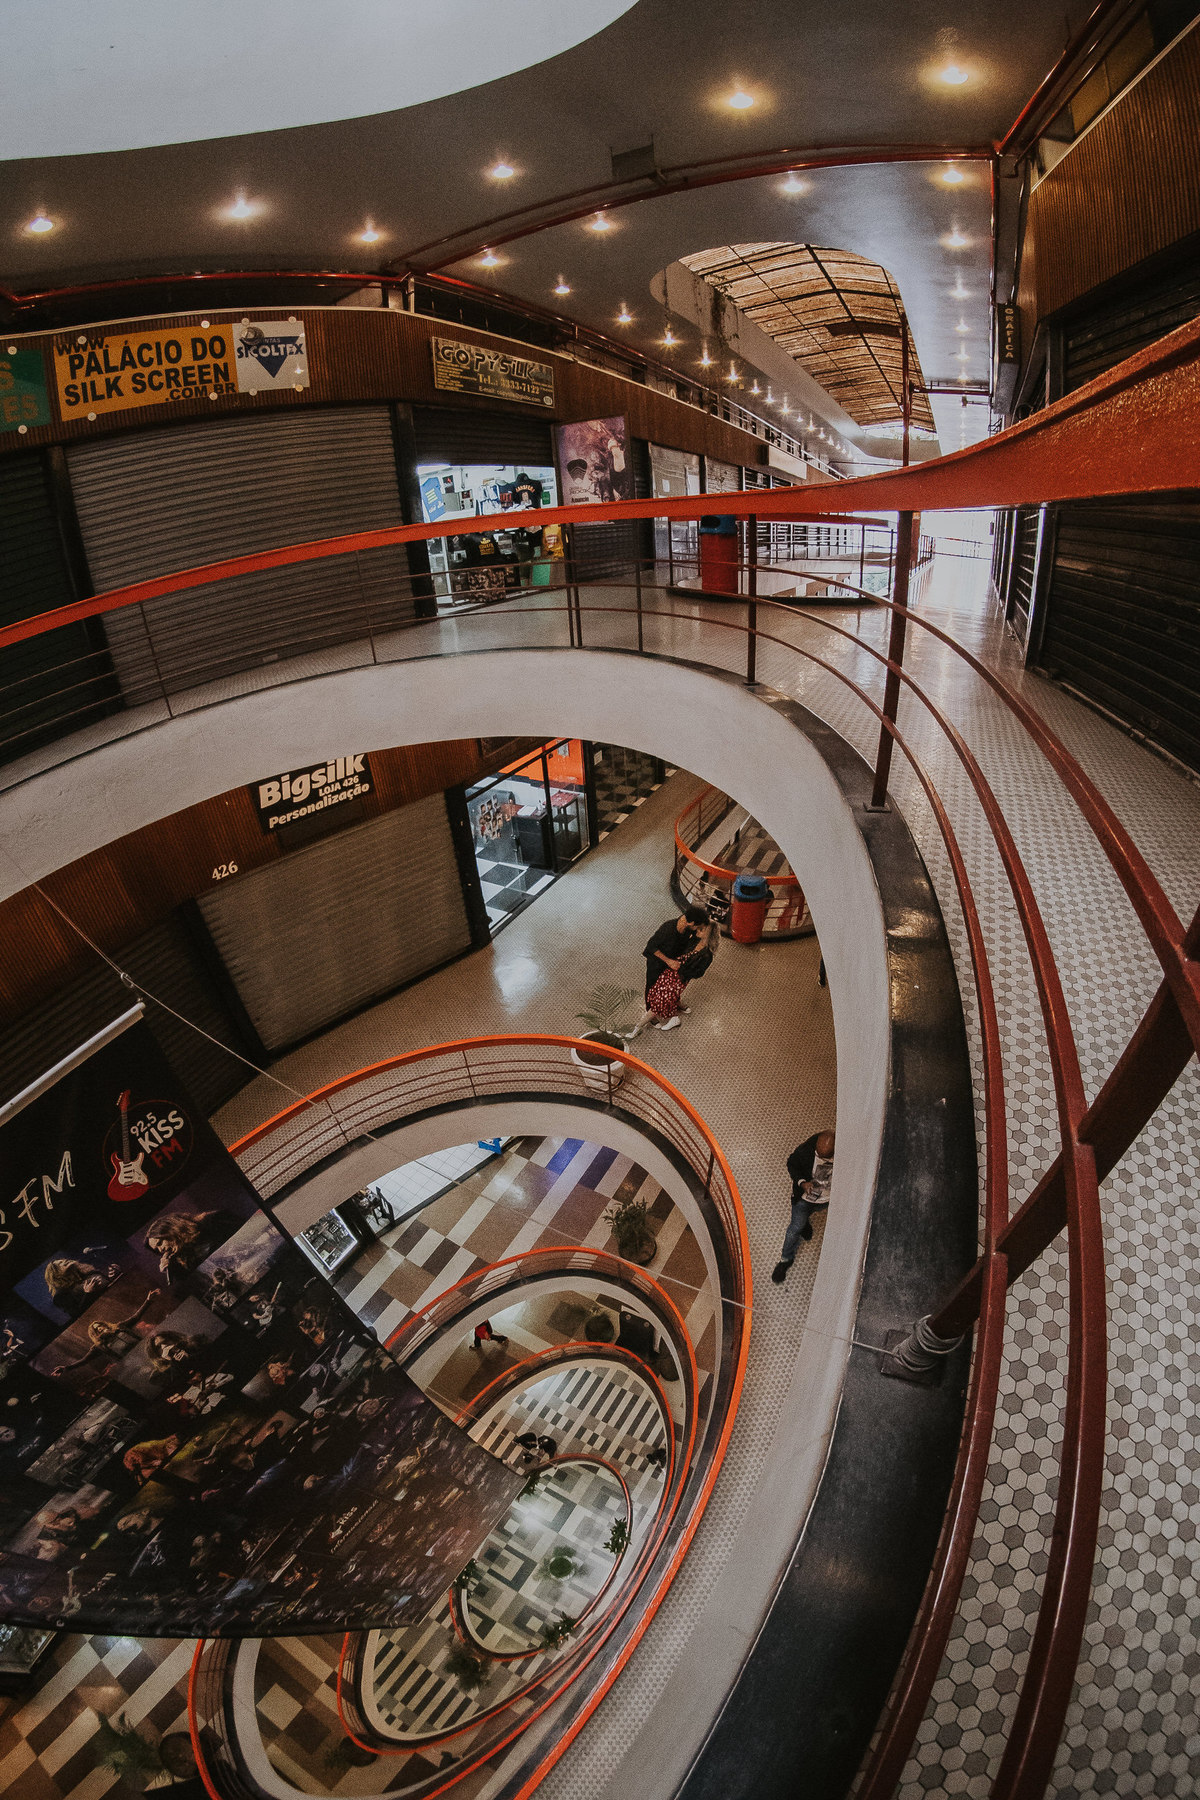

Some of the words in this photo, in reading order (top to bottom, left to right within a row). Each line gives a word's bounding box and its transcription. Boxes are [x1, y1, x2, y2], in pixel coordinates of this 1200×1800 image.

[68, 339, 182, 380] PALÁCIO
[190, 335, 227, 362] DO
[64, 375, 124, 407] SILK
[131, 362, 230, 394] SCREEN
[259, 753, 365, 809] Bigsilk
[319, 782, 341, 797] LOJA
[342, 775, 360, 787] 426
[269, 783, 370, 829] Personalização
[211, 860, 239, 881] 426
[130, 1112, 157, 1137] 92.5
[137, 1110, 185, 1154] KISS
[151, 1137, 183, 1168] FM
